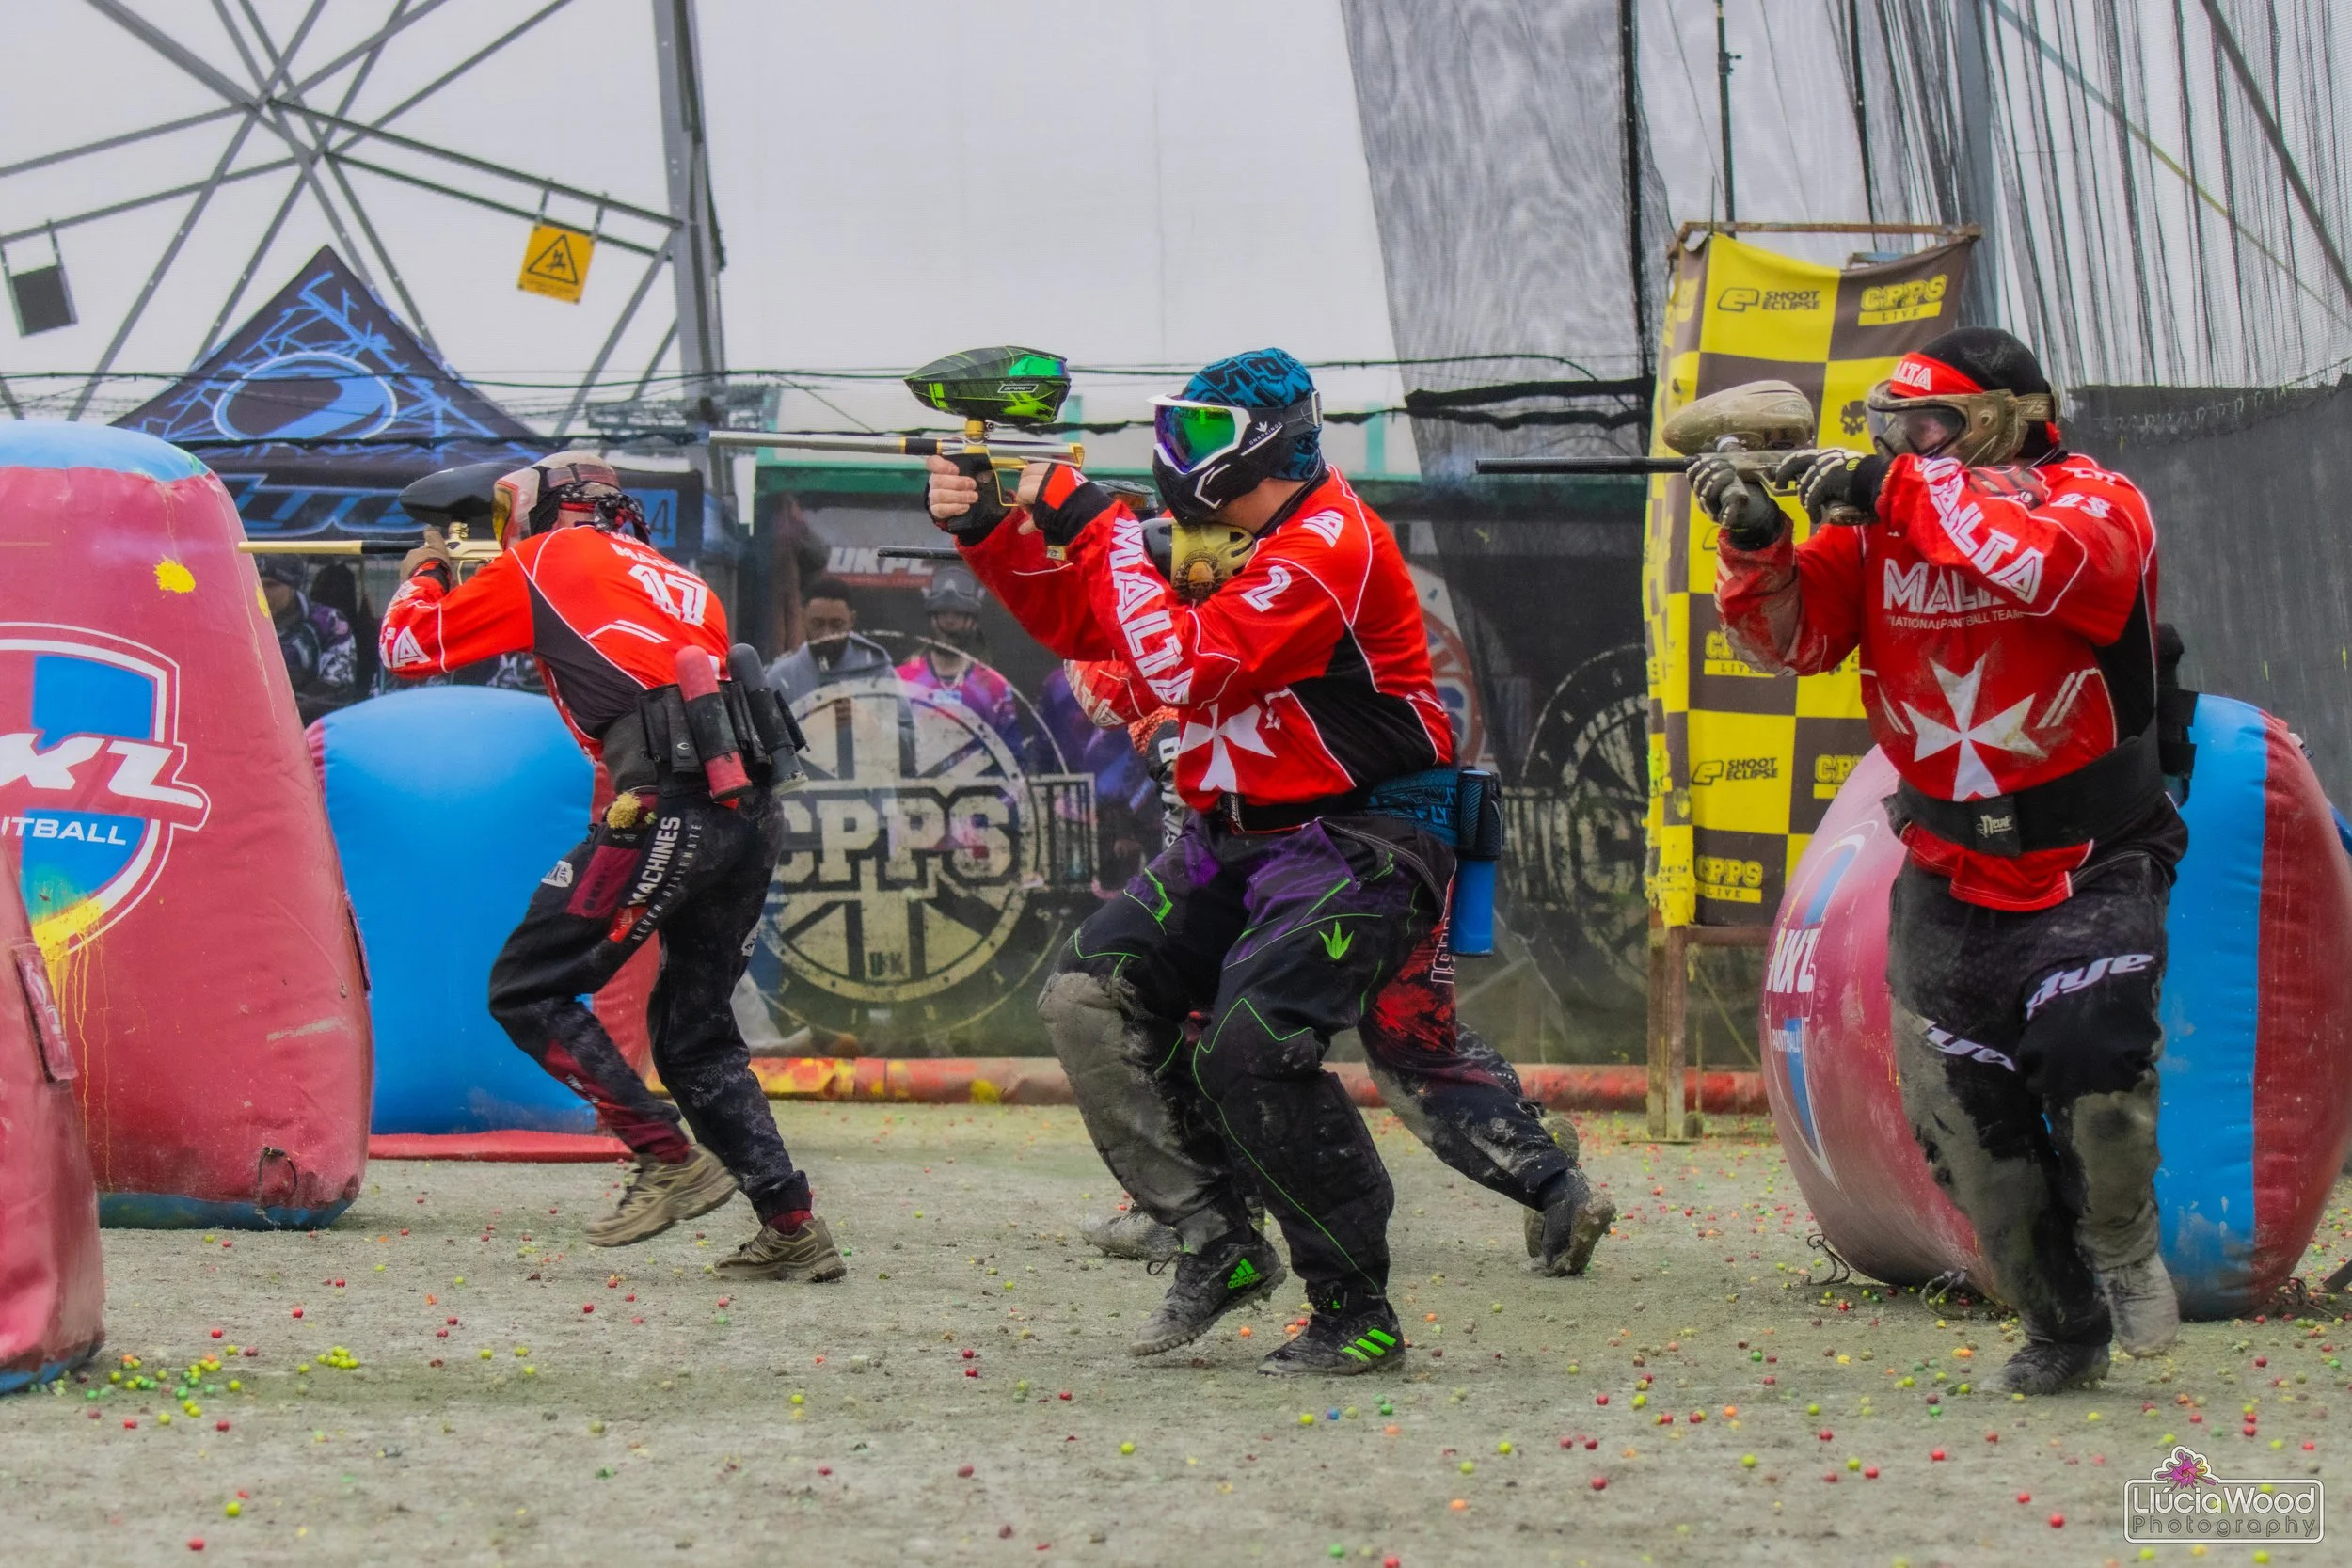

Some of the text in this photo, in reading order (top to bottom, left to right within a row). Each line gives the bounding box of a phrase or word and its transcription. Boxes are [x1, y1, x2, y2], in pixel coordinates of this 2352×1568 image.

[1762, 300, 1820, 310] ECLIPSE
[1764, 290, 1820, 301] SHOOT
[1861, 274, 1948, 311] CPPS
[1882, 309, 1920, 322] LIVE
[628, 564, 707, 626] 17
[1240, 565, 1292, 612] 2
[1883, 558, 2008, 614] MAL
[1108, 516, 1195, 705] MALTA
[1725, 768, 1778, 781] ECLIPSE
[1727, 757, 1777, 769] SHOOT
[628, 816, 681, 906] MACHINES
[1695, 854, 1764, 888] CPPS
[1706, 887, 1742, 899] LIVE
[631, 904, 663, 941] NEVER
